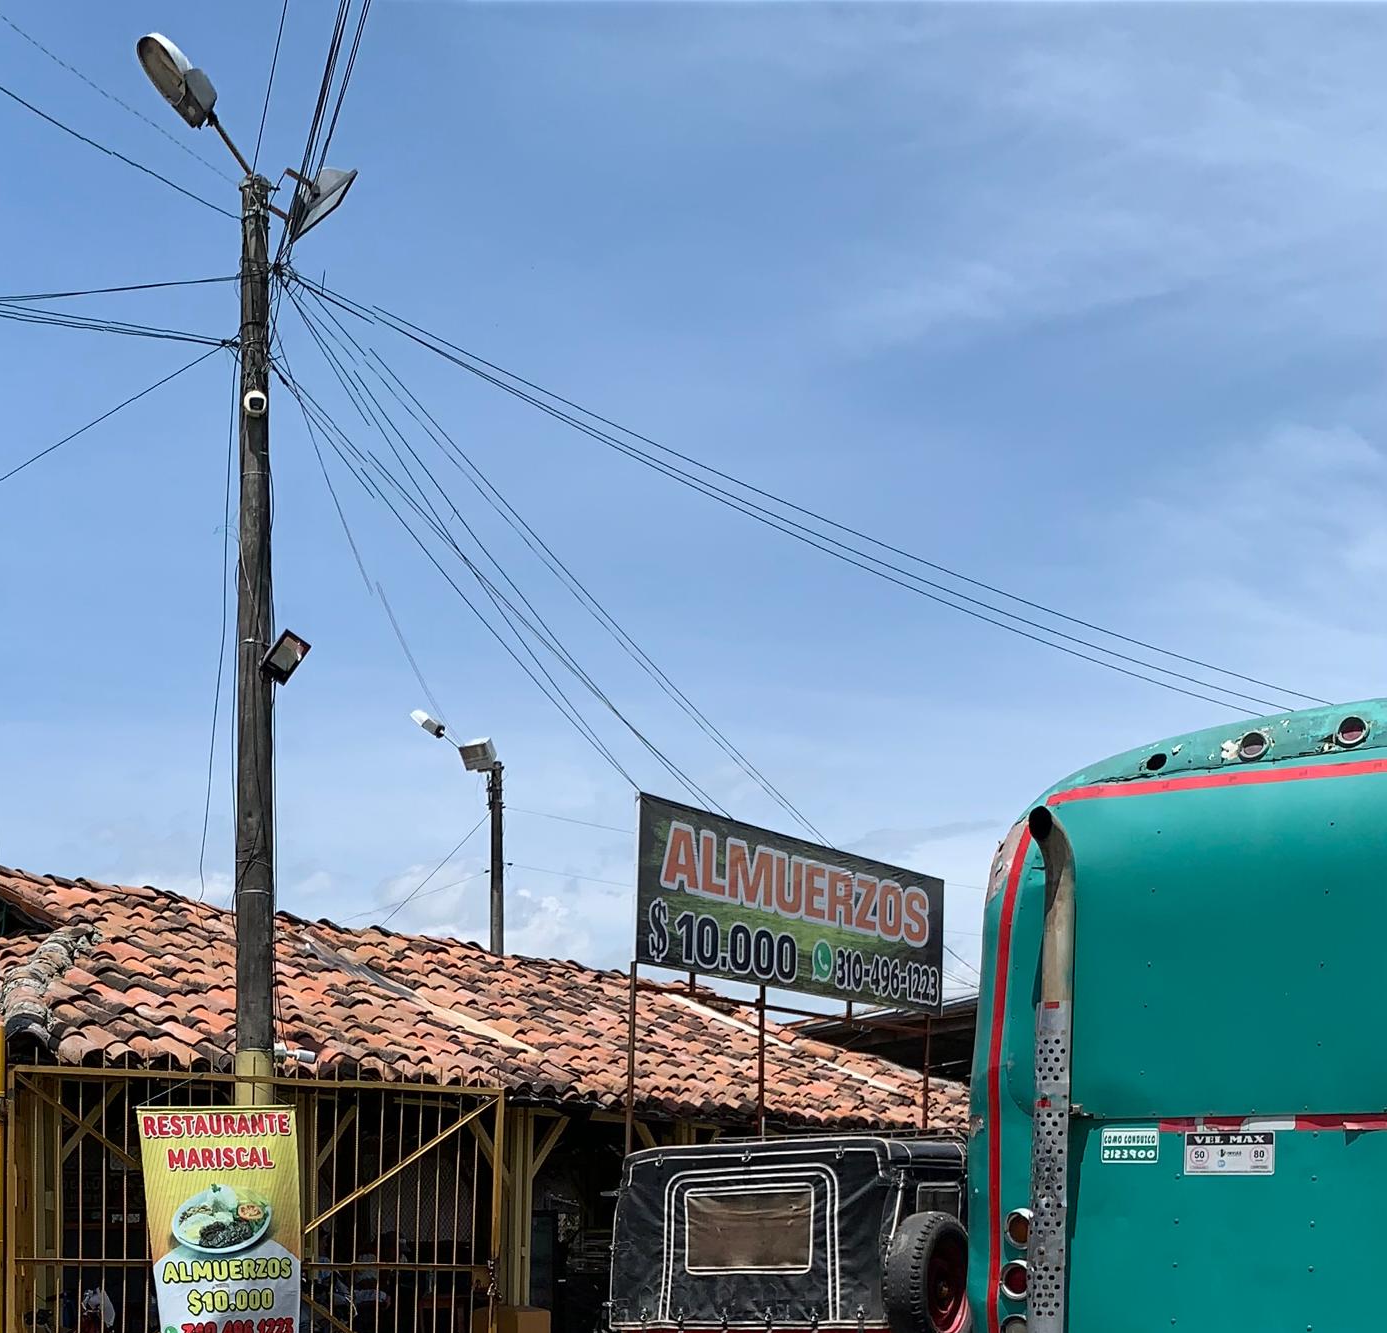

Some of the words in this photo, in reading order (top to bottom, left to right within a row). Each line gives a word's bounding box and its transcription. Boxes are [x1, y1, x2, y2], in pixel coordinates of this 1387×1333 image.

[660, 821, 929, 948] ALMUERZOS
[835, 947, 939, 1006] 310-496-1223
[143, 1113, 291, 1138] RESTAURANTE
[1104, 1135, 1122, 1144] COMO
[1230, 1135, 1265, 1144] MAX
[167, 1147, 275, 1170] MARISCAL
[1194, 1151, 1205, 1159] 50
[1254, 1150, 1265, 1158] 80
[162, 1258, 292, 1284] ALMUERZOS
[187, 1288, 275, 1316] $10.000
